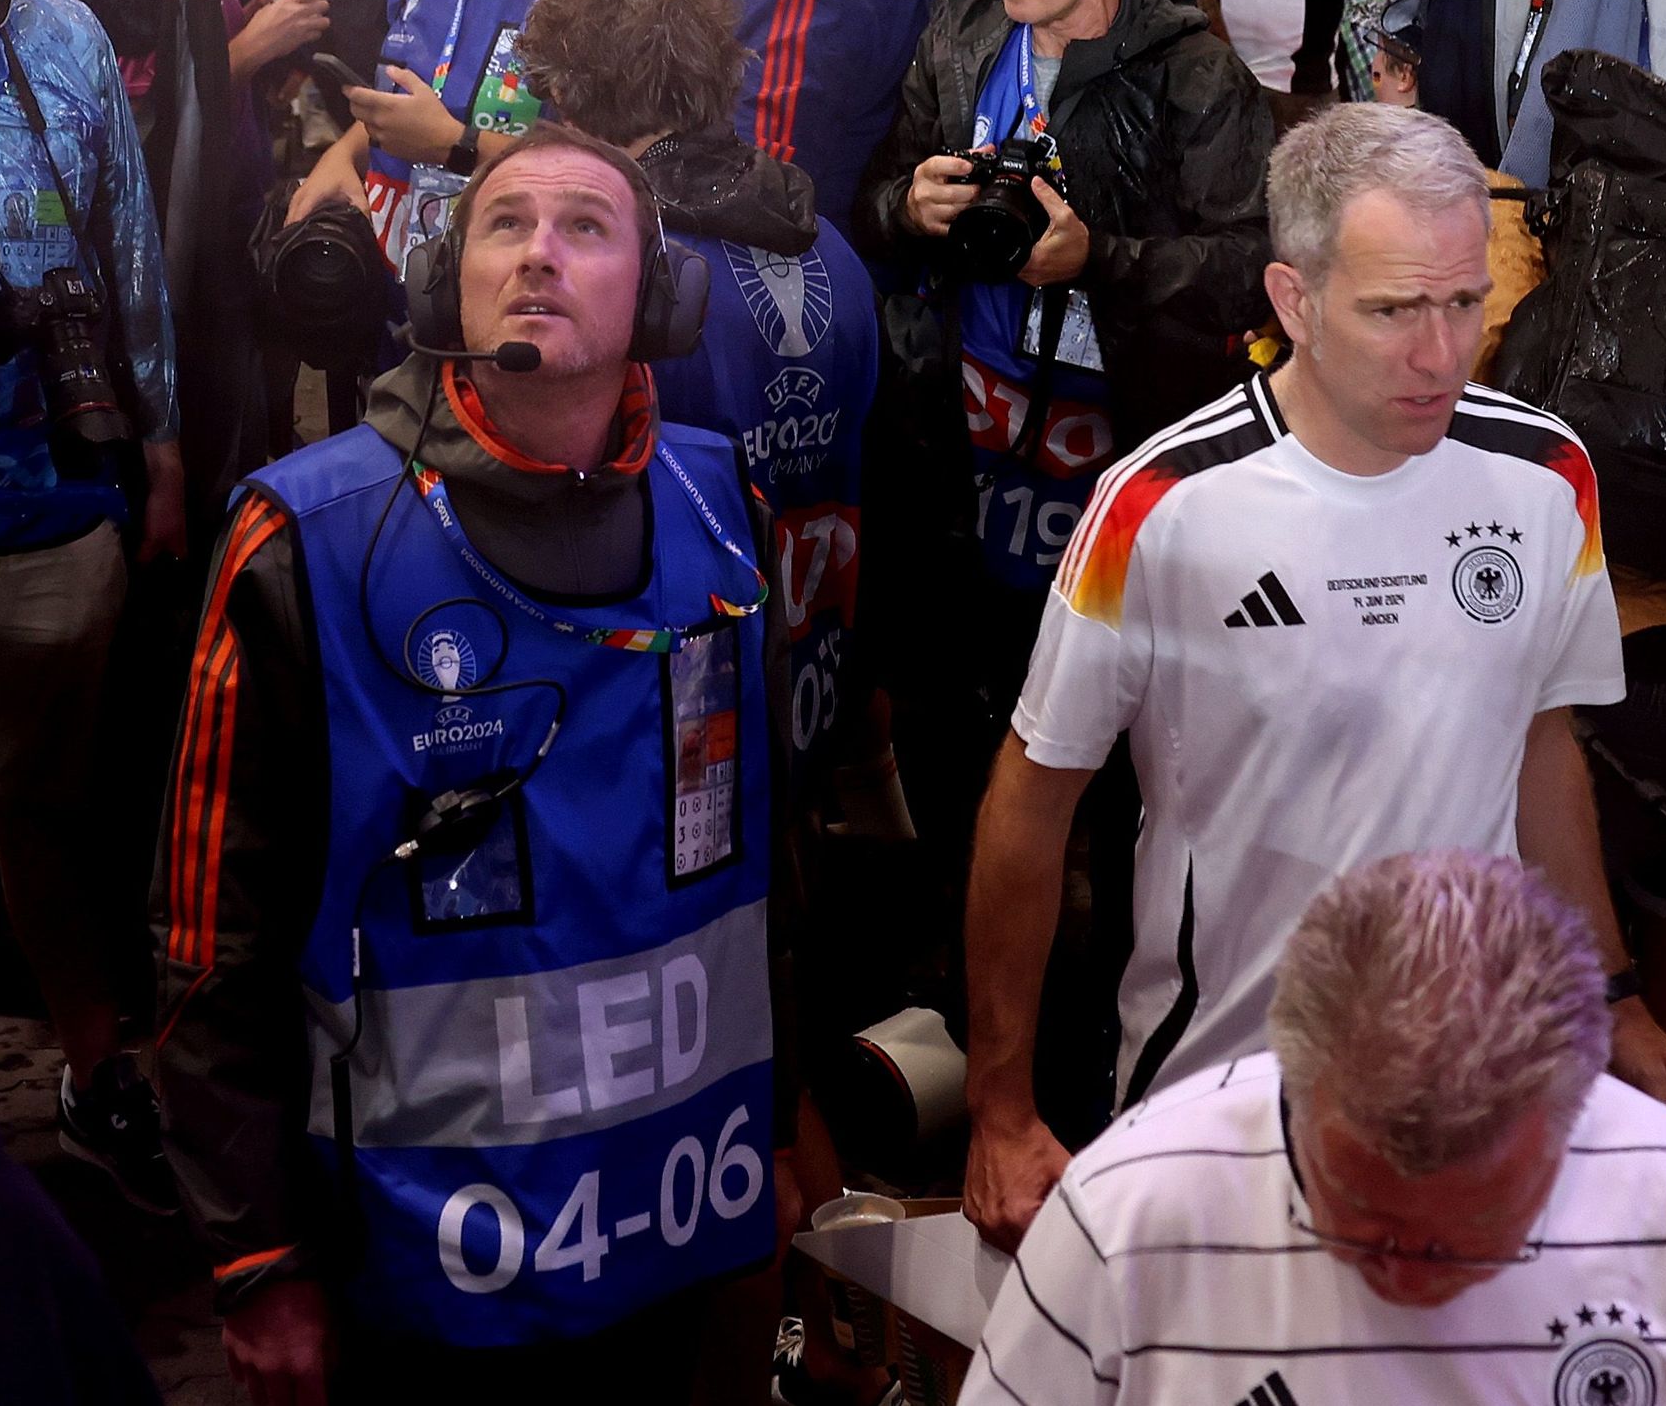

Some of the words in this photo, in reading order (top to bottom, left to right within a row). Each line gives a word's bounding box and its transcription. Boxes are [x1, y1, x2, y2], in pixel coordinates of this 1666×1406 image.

[1003, 160, 1024, 170] SONY
[767, 374, 821, 405] UEFA
[662, 447, 722, 535] UEFAEURO2024
[437, 708, 470, 723] UEFA
[413, 718, 503, 752] EURO2024
[494, 953, 709, 1125] LED
[438, 1105, 764, 1294] 04-06
